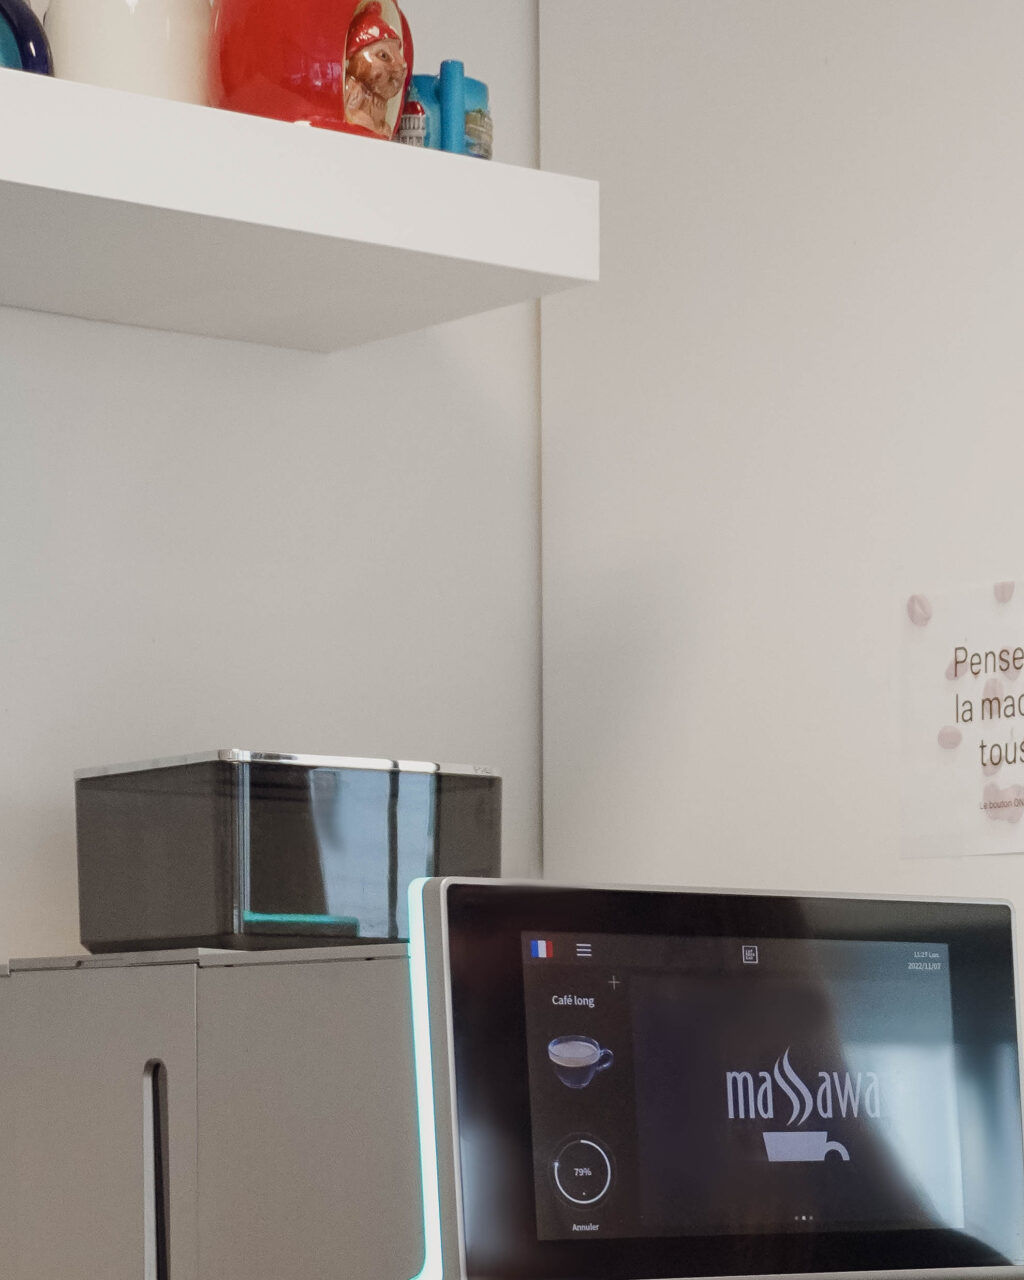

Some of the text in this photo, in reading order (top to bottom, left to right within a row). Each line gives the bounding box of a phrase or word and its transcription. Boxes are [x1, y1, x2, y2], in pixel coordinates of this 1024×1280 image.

[955, 693, 973, 724] la
[988, 800, 1013, 809] bouton
[551, 995, 595, 1008] Café long
[572, 1223, 600, 1231] Annuler
